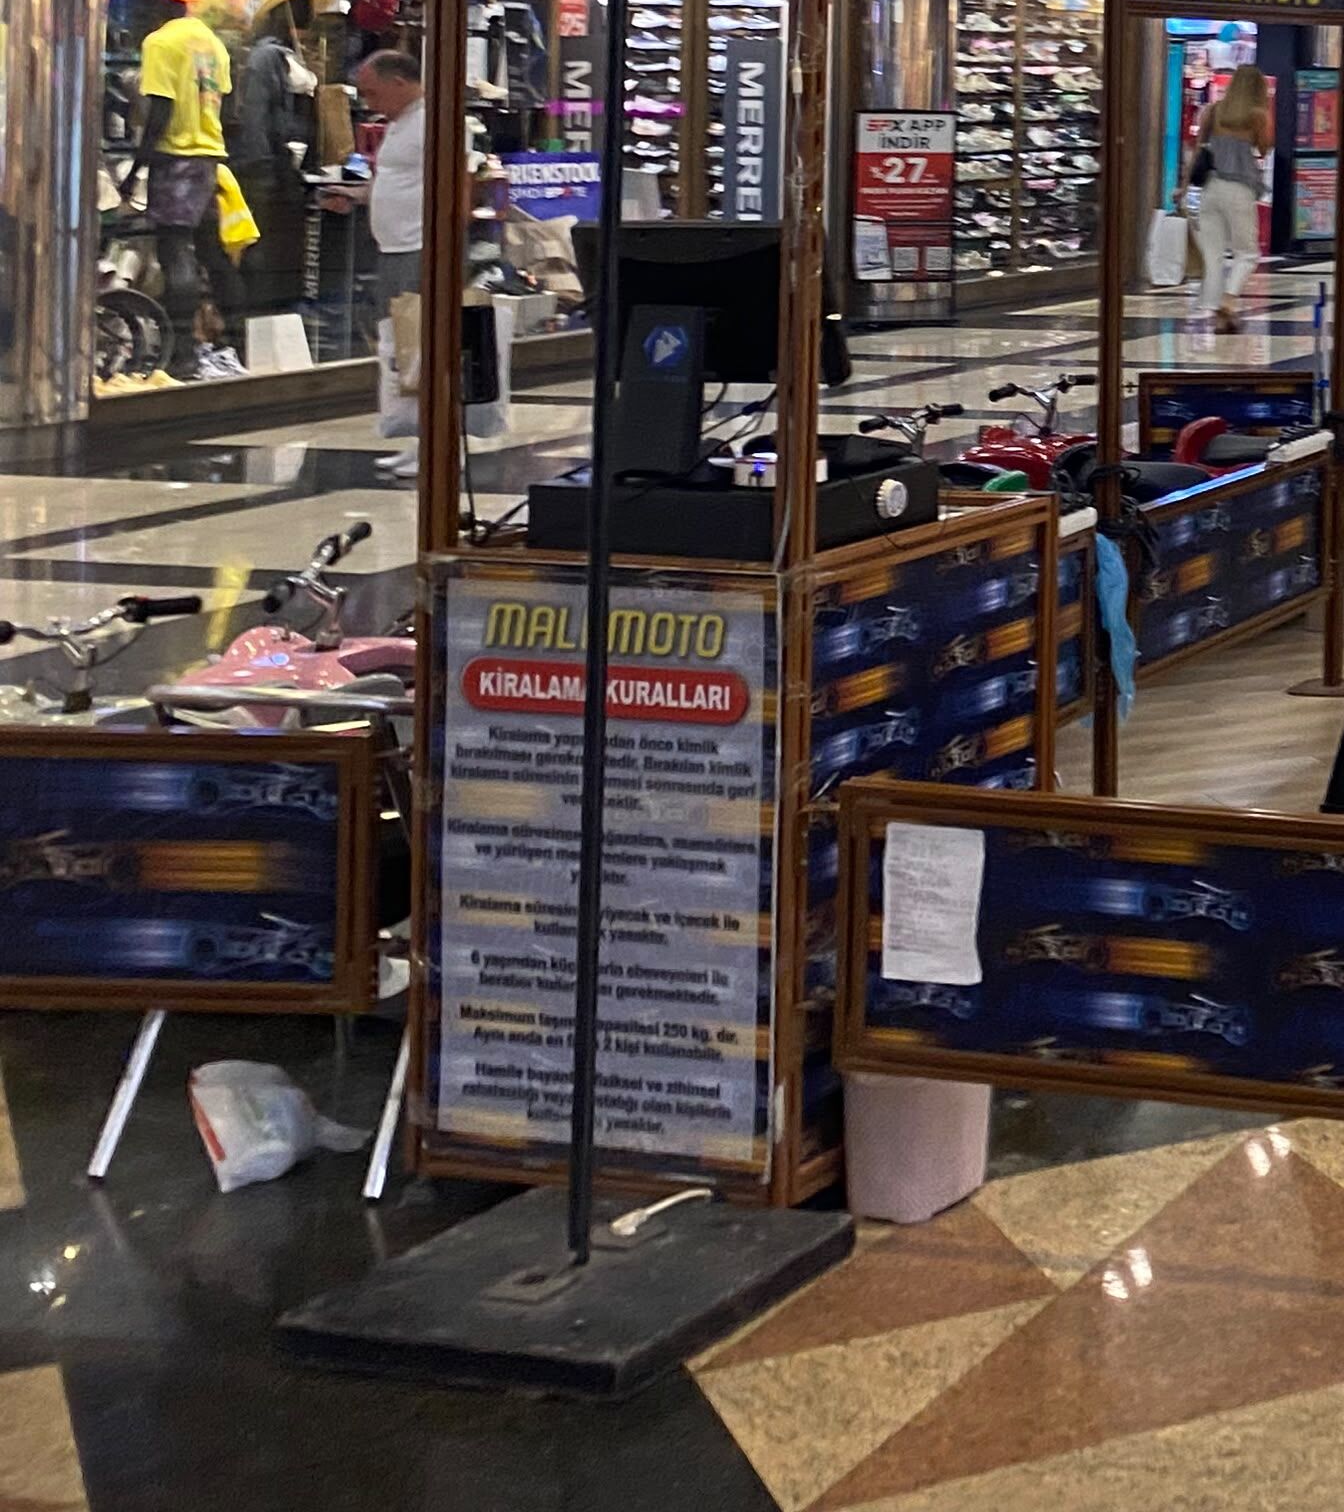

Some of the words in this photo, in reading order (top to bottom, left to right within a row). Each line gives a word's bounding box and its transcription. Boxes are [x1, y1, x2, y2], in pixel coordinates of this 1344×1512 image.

[485, 602, 725, 659] MALMOTO
[607, 677, 730, 710] KURALLARI
[664, 1021, 688, 1038] 250
